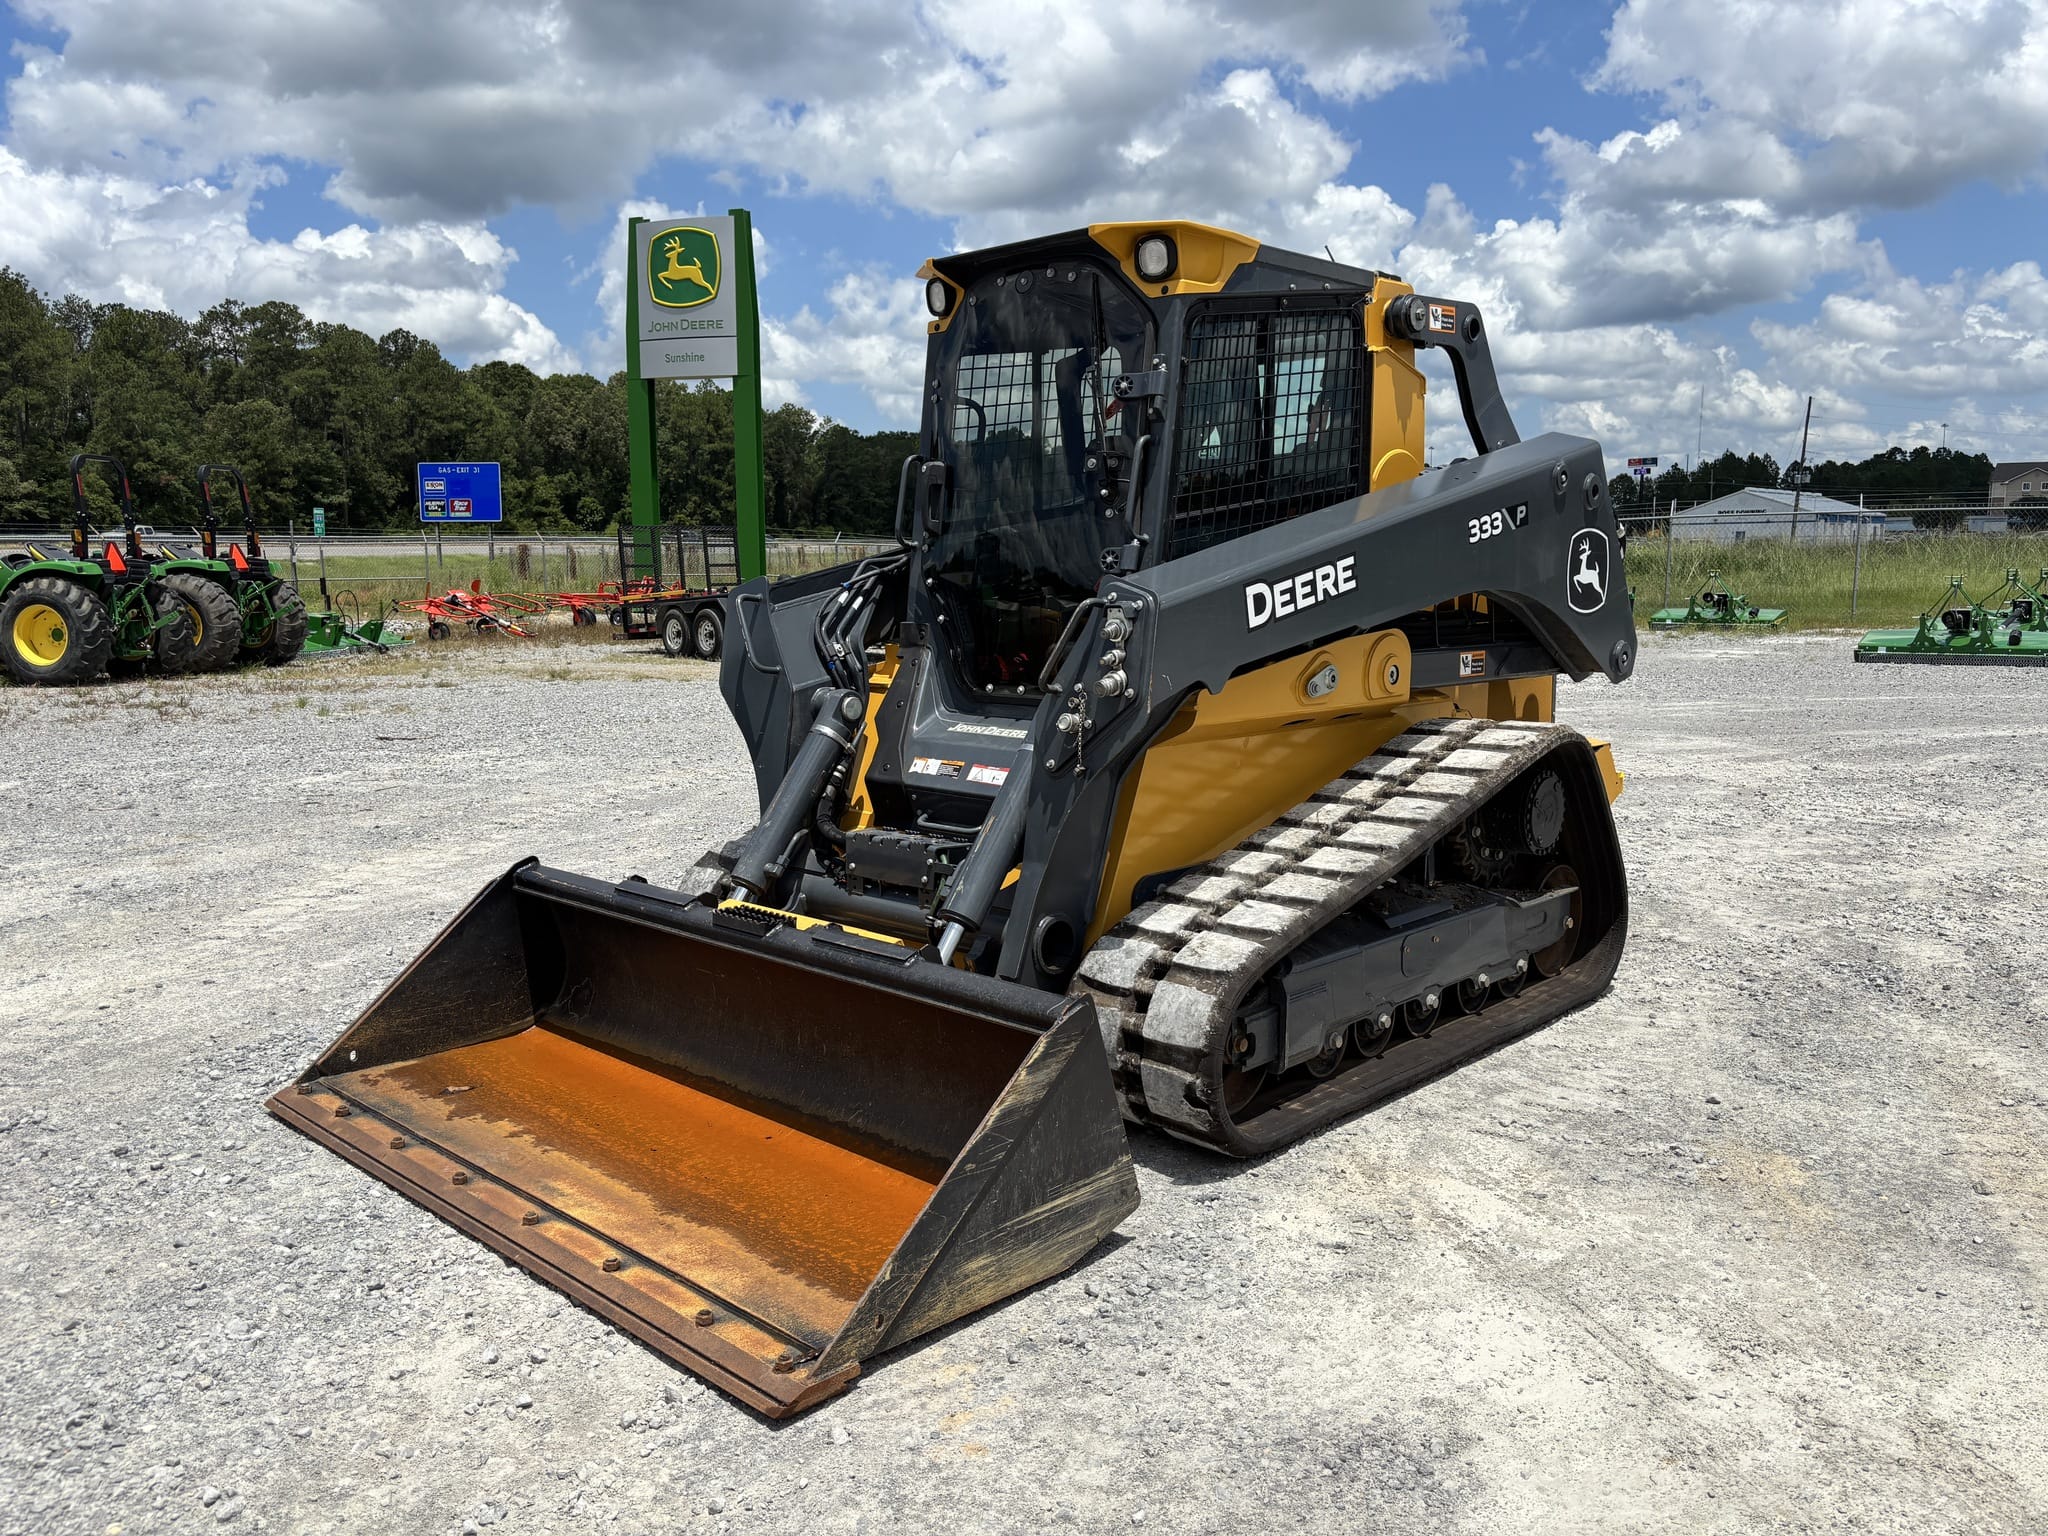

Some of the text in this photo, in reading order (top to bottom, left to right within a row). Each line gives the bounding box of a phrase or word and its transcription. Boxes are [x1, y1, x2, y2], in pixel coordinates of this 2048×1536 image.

[648, 319, 724, 332] JOHN DEERE
[665, 352, 704, 363] Sunshine
[1468, 511, 1503, 543] 333
[1245, 556, 1357, 629] DEERE
[947, 723, 1028, 738] JOHN DEERE
